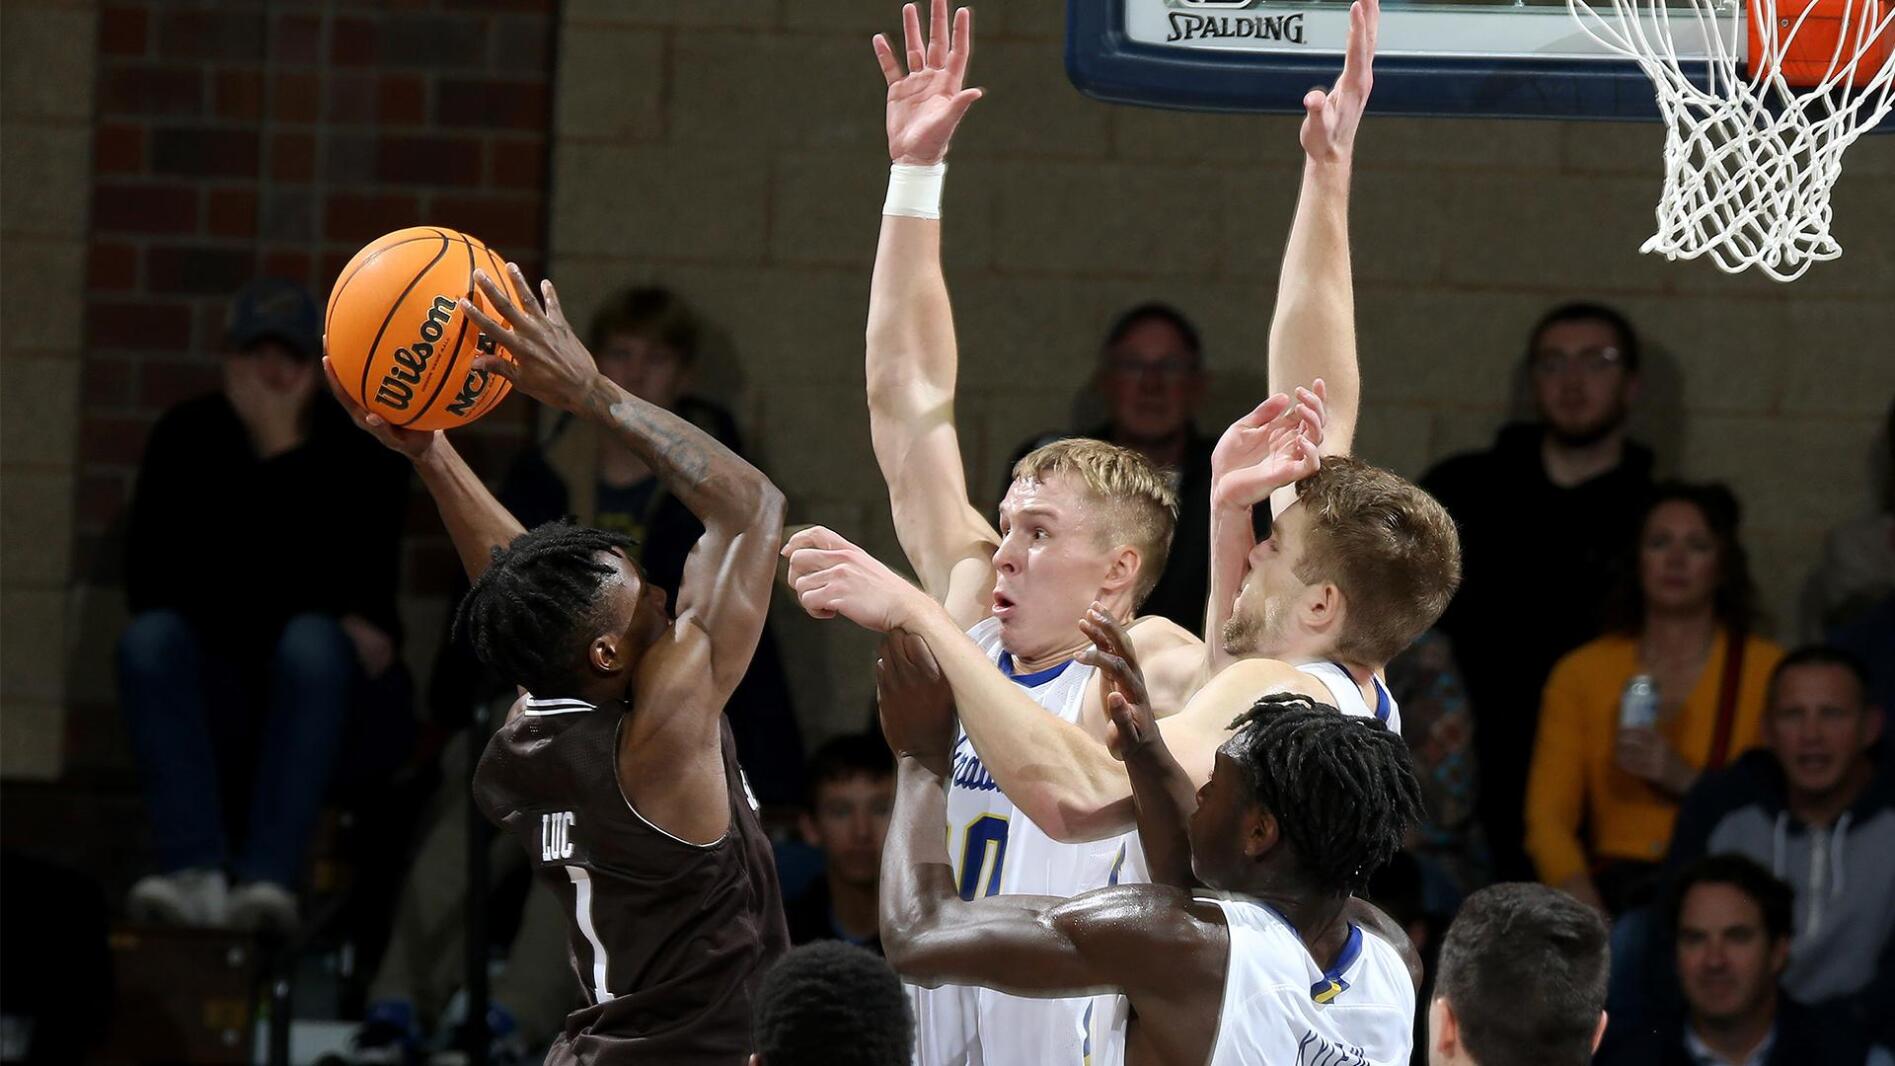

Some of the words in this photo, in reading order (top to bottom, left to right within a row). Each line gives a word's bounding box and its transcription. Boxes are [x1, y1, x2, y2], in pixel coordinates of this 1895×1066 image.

[1167, 11, 1304, 44] SPALDING
[374, 295, 457, 411] Wilson
[542, 811, 575, 861] LUC
[565, 865, 615, 1005] 1
